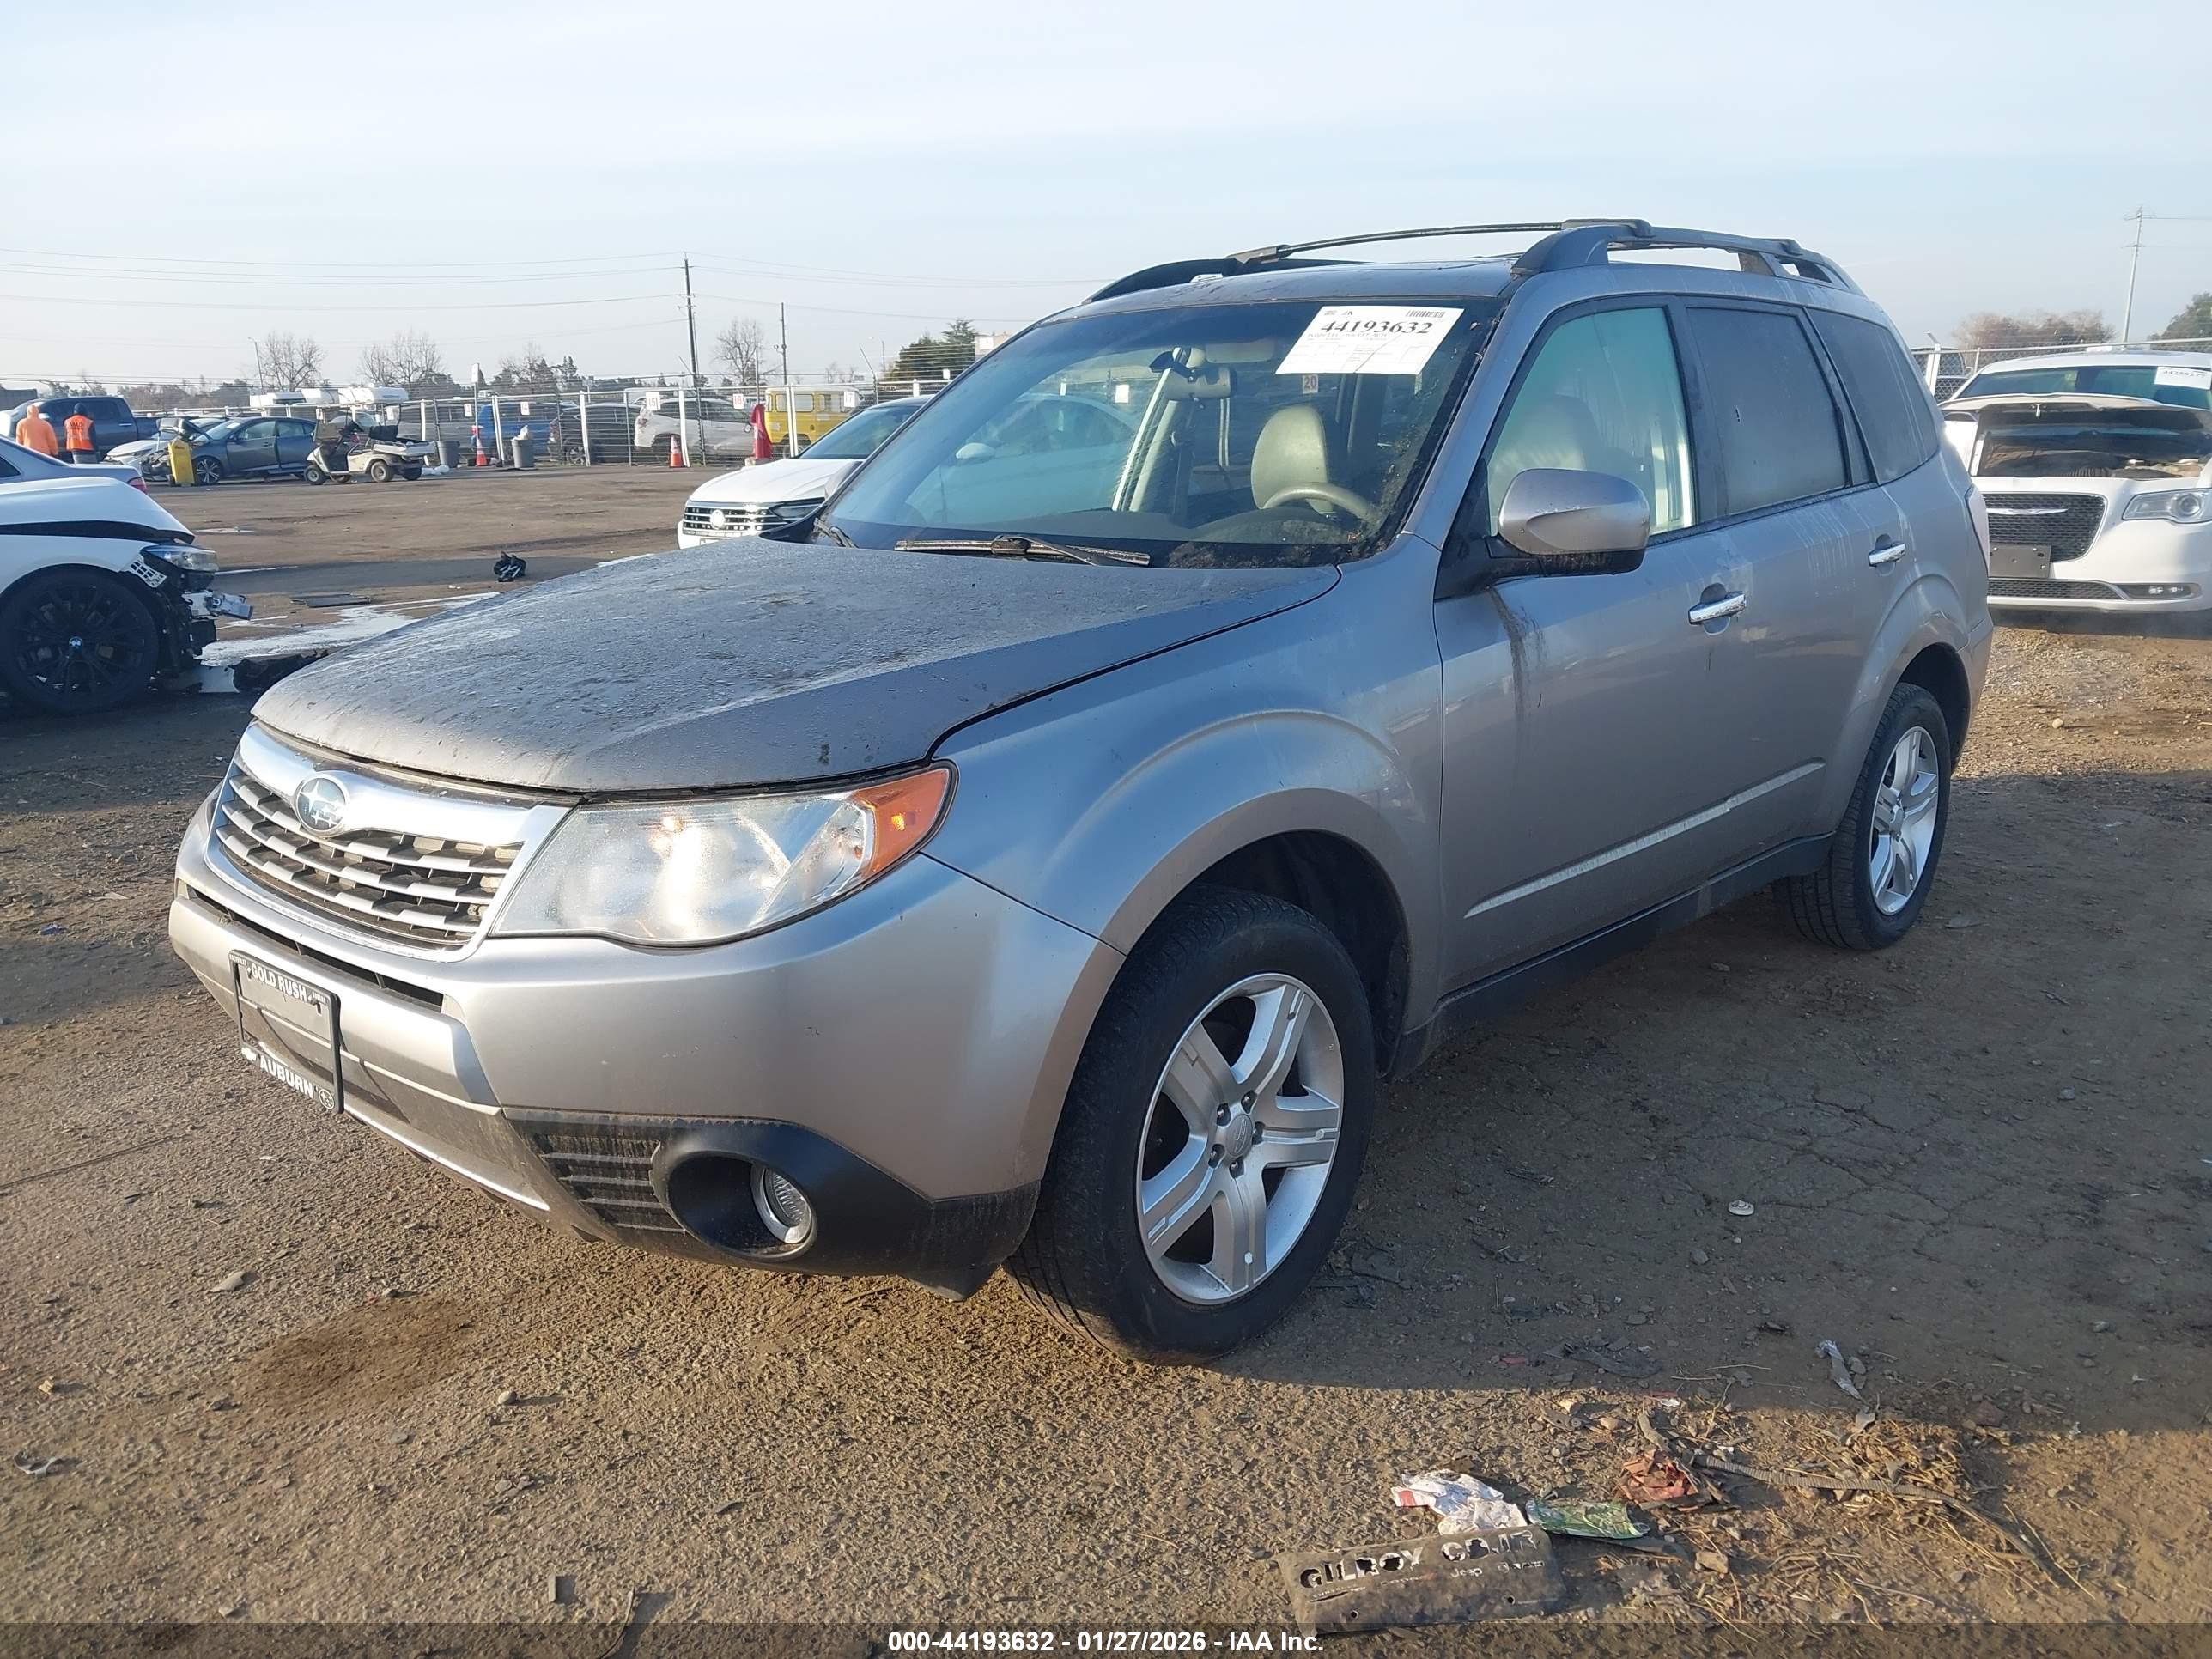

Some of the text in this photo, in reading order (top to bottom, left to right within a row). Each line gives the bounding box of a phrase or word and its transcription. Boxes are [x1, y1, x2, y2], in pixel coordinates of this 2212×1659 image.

[1321, 320, 1433, 334] 44193632
[1304, 375, 1317, 387] 20
[251, 963, 307, 1002] GOLD RUSH
[259, 1054, 313, 1099] AUBURN
[1299, 1547, 1423, 1589] GILROY
